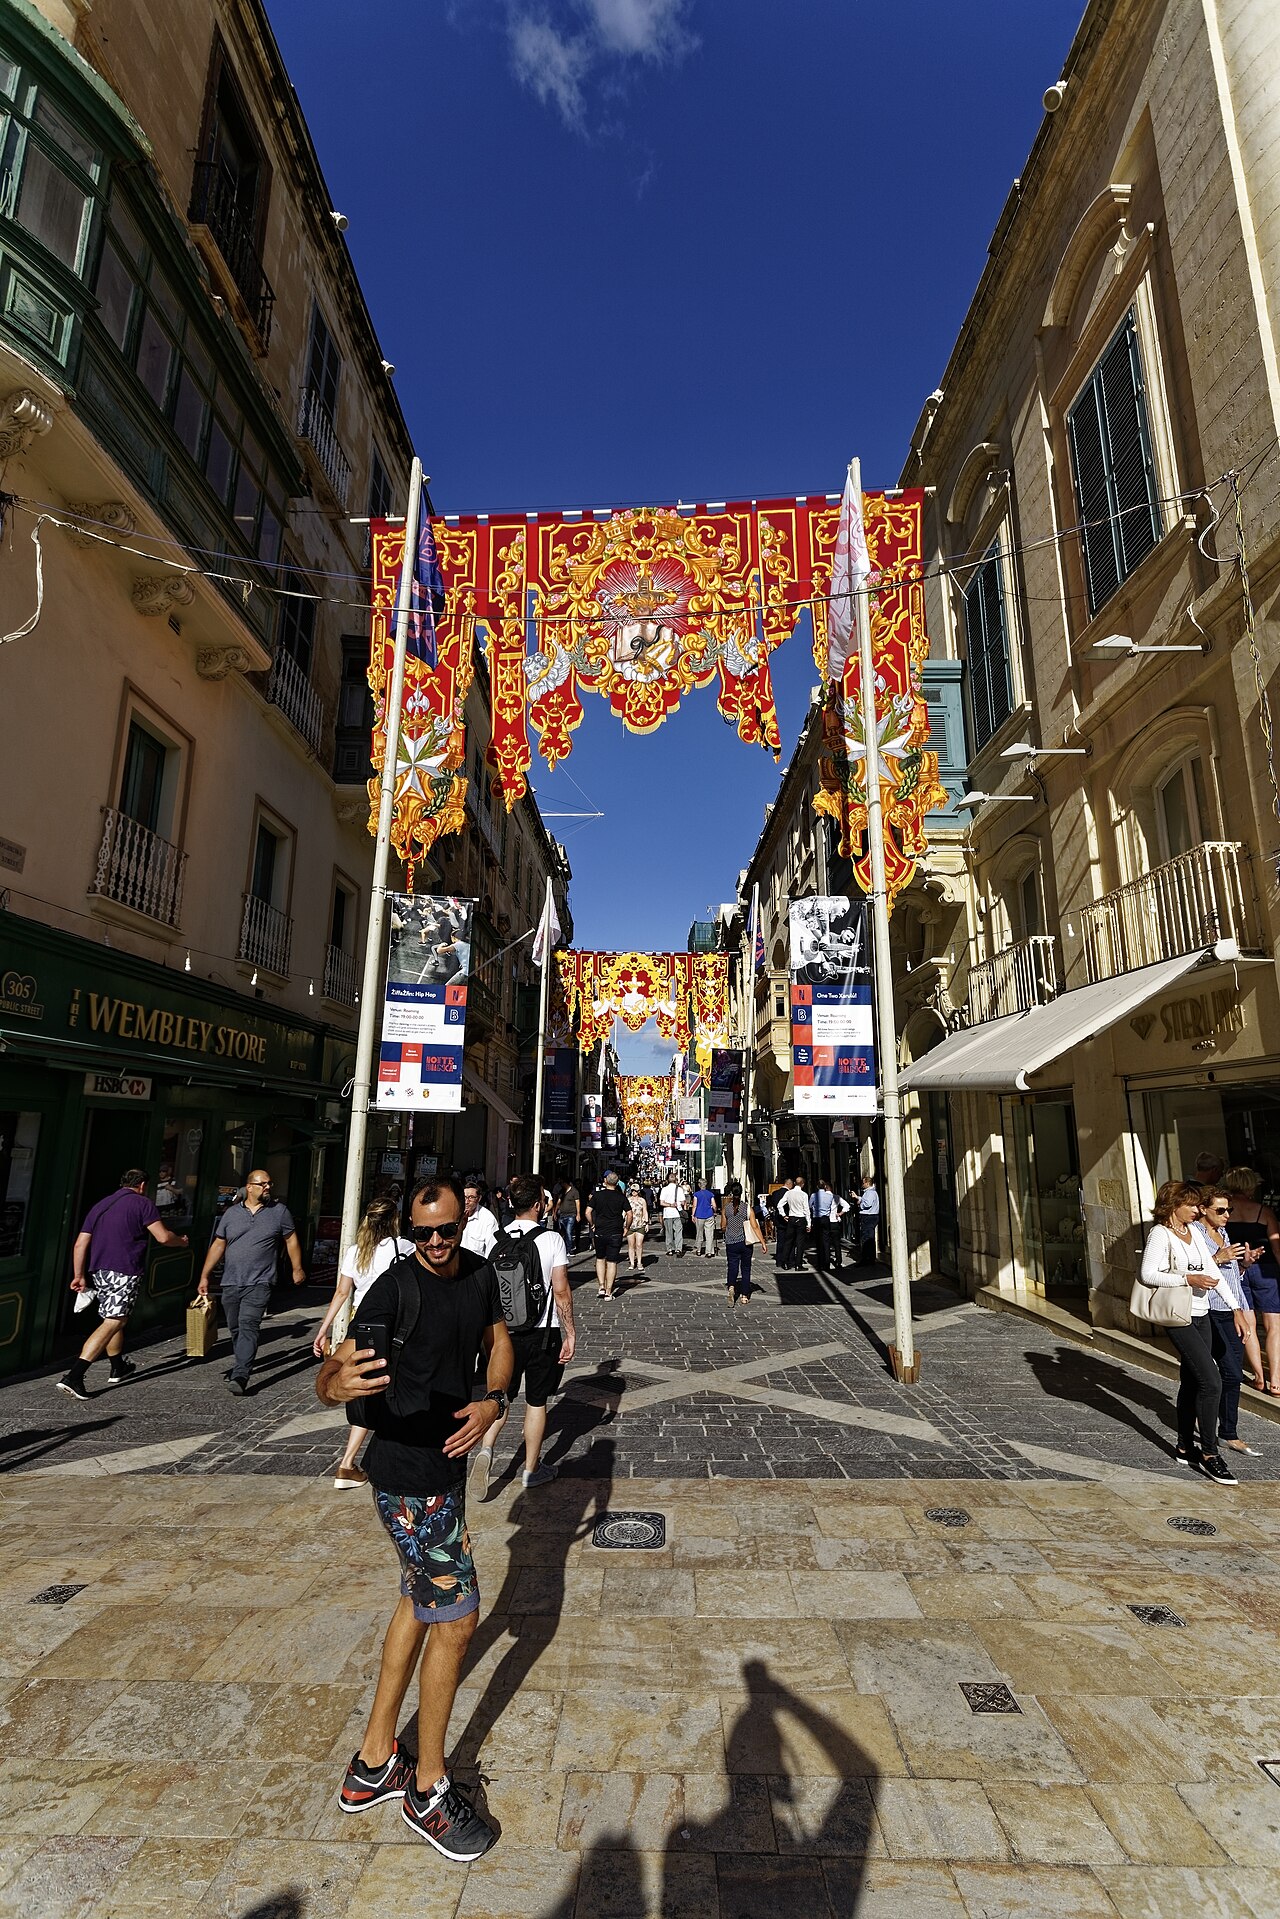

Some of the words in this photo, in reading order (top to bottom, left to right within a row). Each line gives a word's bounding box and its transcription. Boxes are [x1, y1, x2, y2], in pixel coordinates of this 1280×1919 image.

[7, 980, 31, 999] 305
[415, 991, 425, 999] Hip
[20, 1004, 41, 1016] STREET
[69, 988, 82, 1027] THE
[88, 992, 214, 1052] WEMBLEY
[215, 1026, 267, 1064] STORE
[94, 1076, 130, 1094] HSBC
